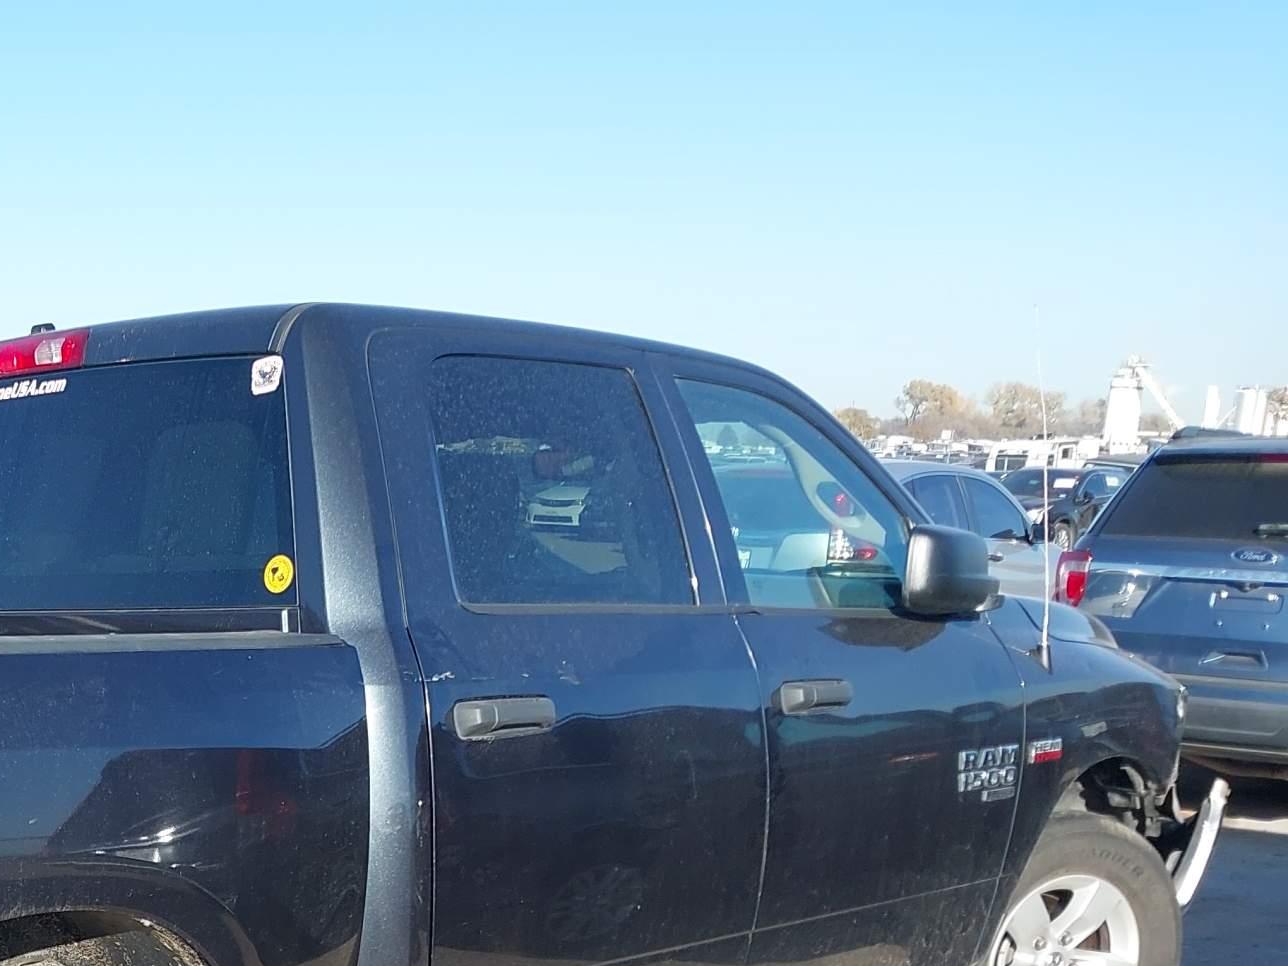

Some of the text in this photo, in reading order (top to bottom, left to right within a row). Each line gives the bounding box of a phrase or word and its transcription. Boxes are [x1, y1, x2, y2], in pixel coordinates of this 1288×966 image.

[1238, 550, 1269, 562] Ford
[958, 745, 1019, 771] RAM
[957, 766, 1017, 792] 1500
